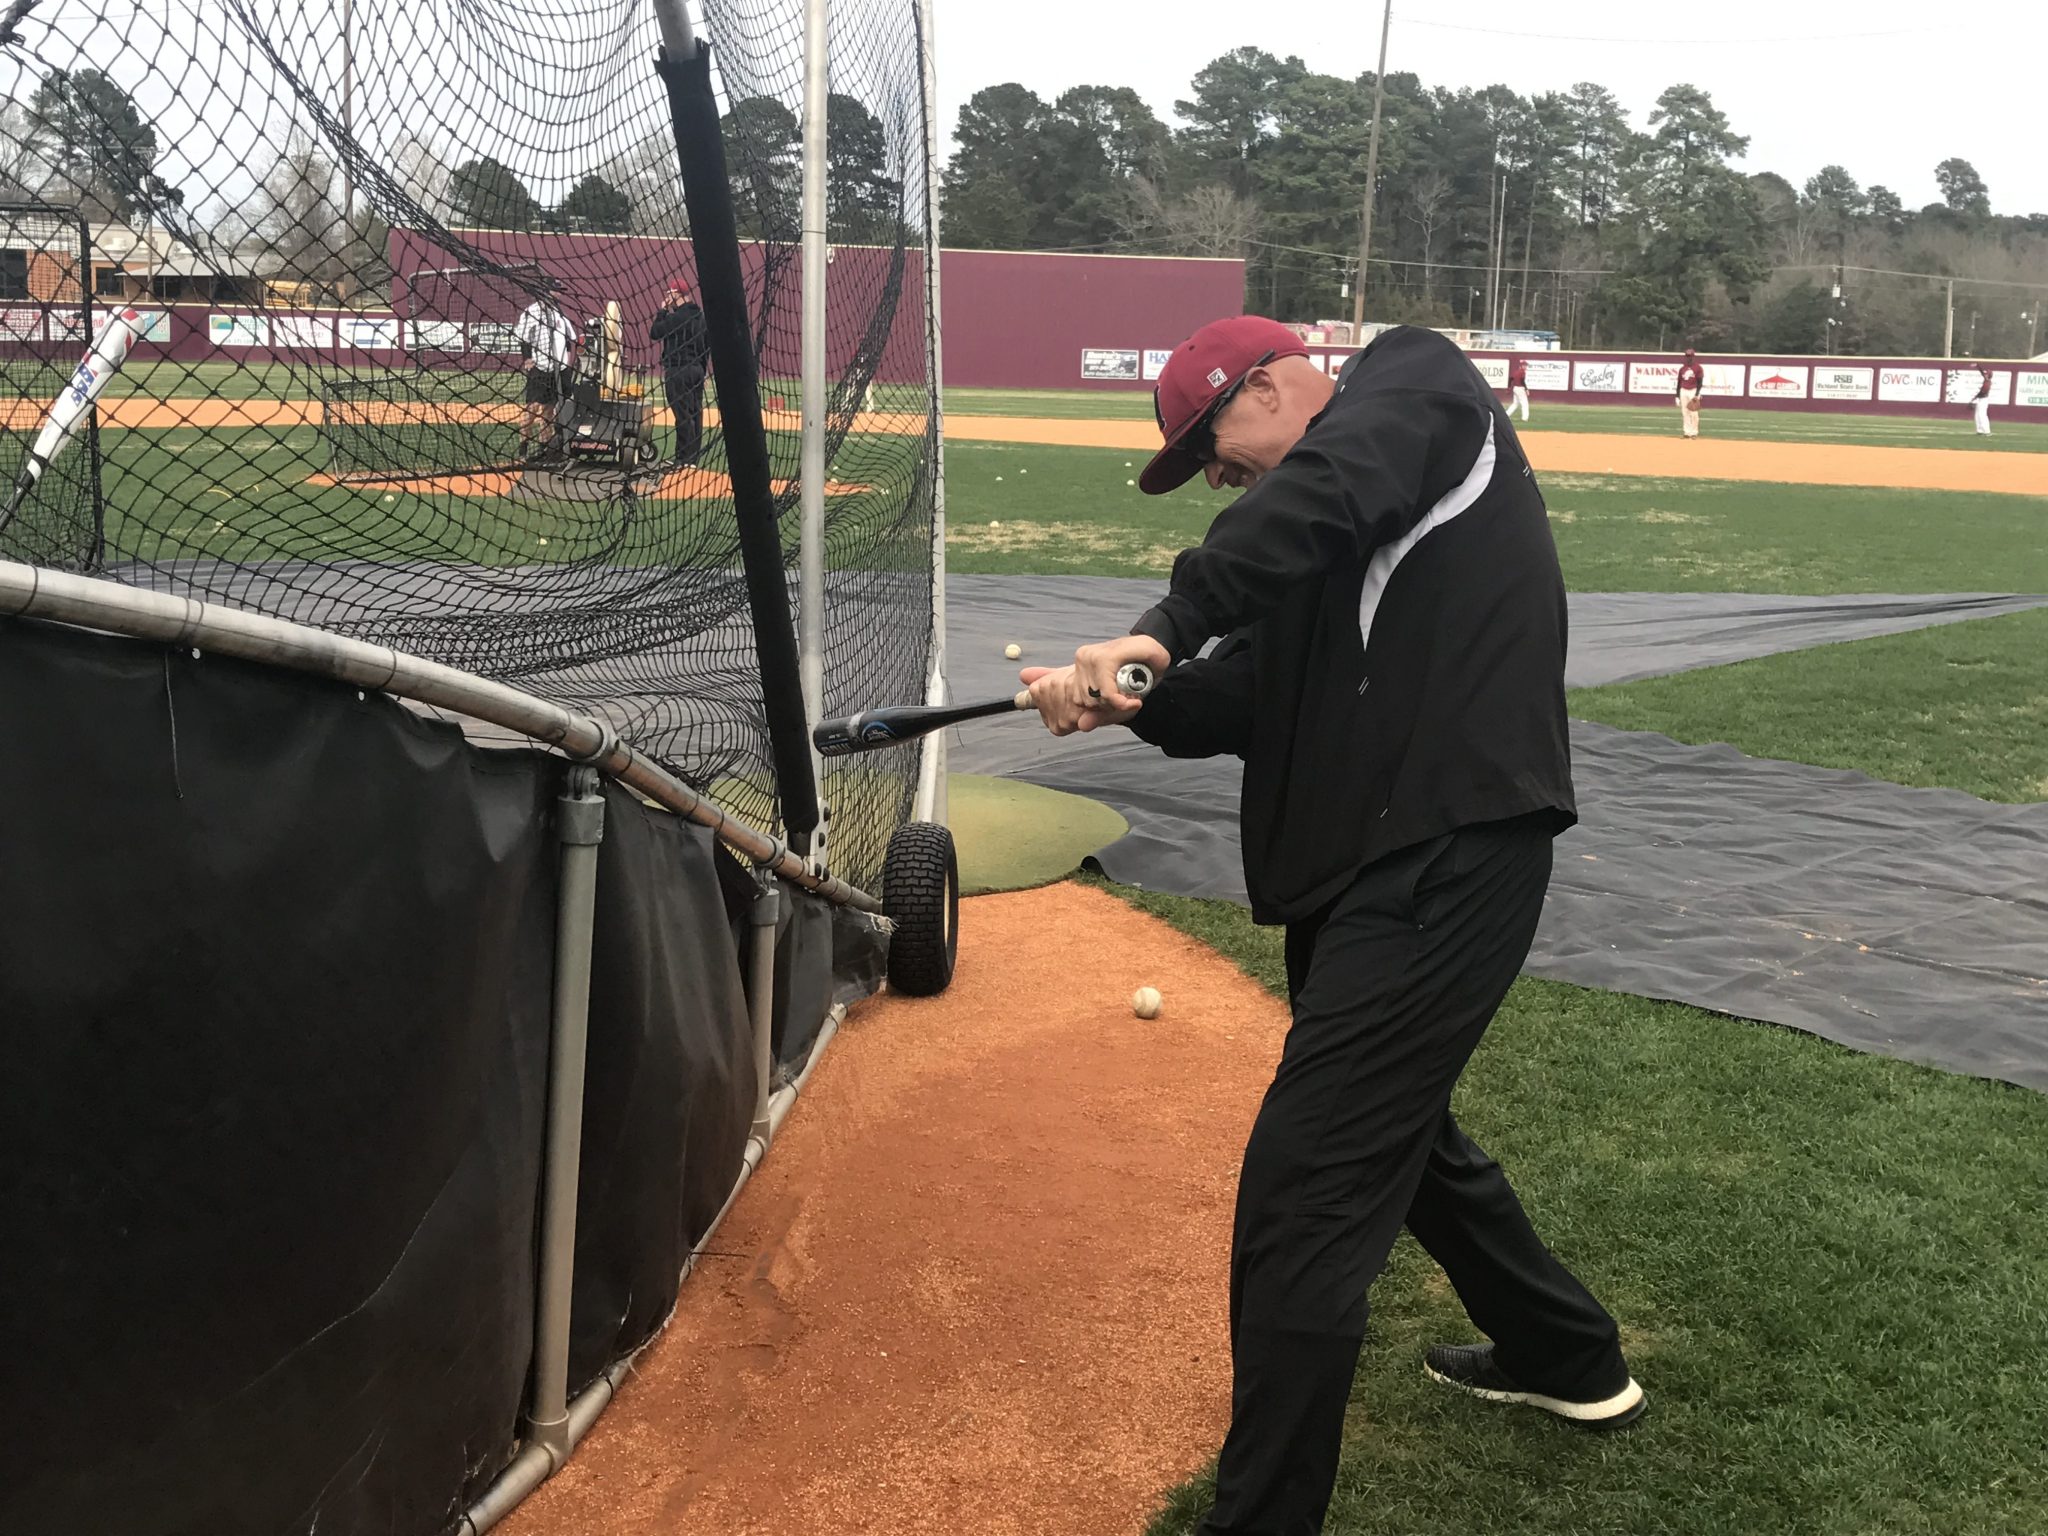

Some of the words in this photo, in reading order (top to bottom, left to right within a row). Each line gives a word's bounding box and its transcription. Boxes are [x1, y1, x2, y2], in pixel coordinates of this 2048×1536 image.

[1478, 366, 1504, 377] OLDS
[1579, 363, 1617, 388] Easley
[1634, 366, 1679, 377] WATKINS
